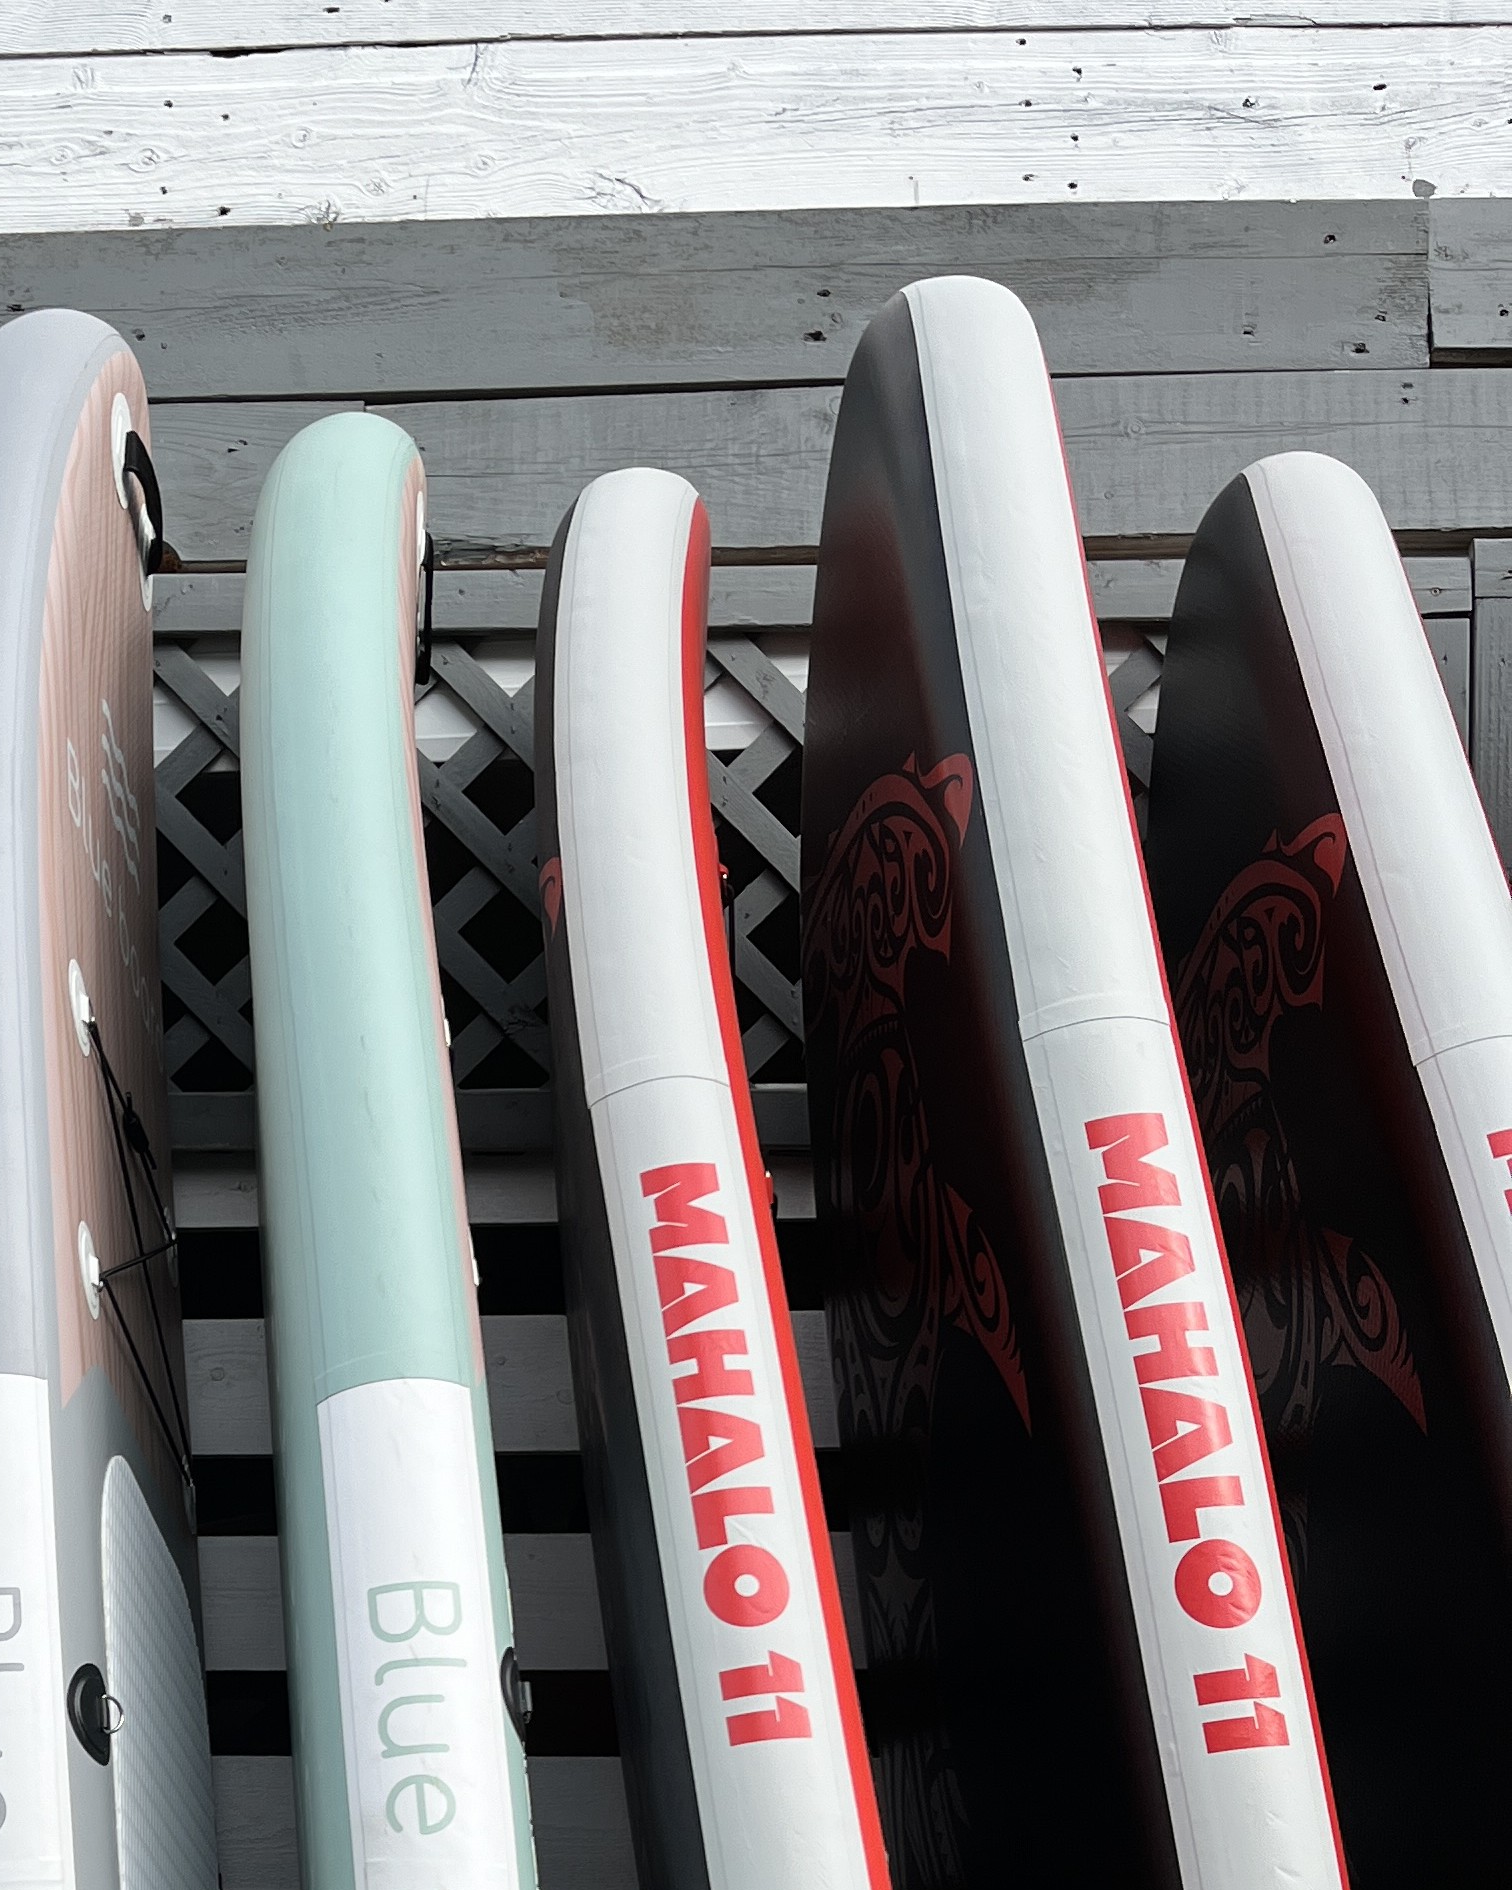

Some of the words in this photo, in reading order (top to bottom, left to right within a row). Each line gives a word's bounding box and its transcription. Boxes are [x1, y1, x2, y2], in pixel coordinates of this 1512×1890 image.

[67, 737, 112, 918] Blue
[641, 1162, 790, 1628] MAHALO
[720, 1650, 811, 1747] 11
[1085, 1113, 1261, 1630] MAHALO
[1194, 1653, 1289, 1755] 11
[367, 1580, 468, 1836] Blue
